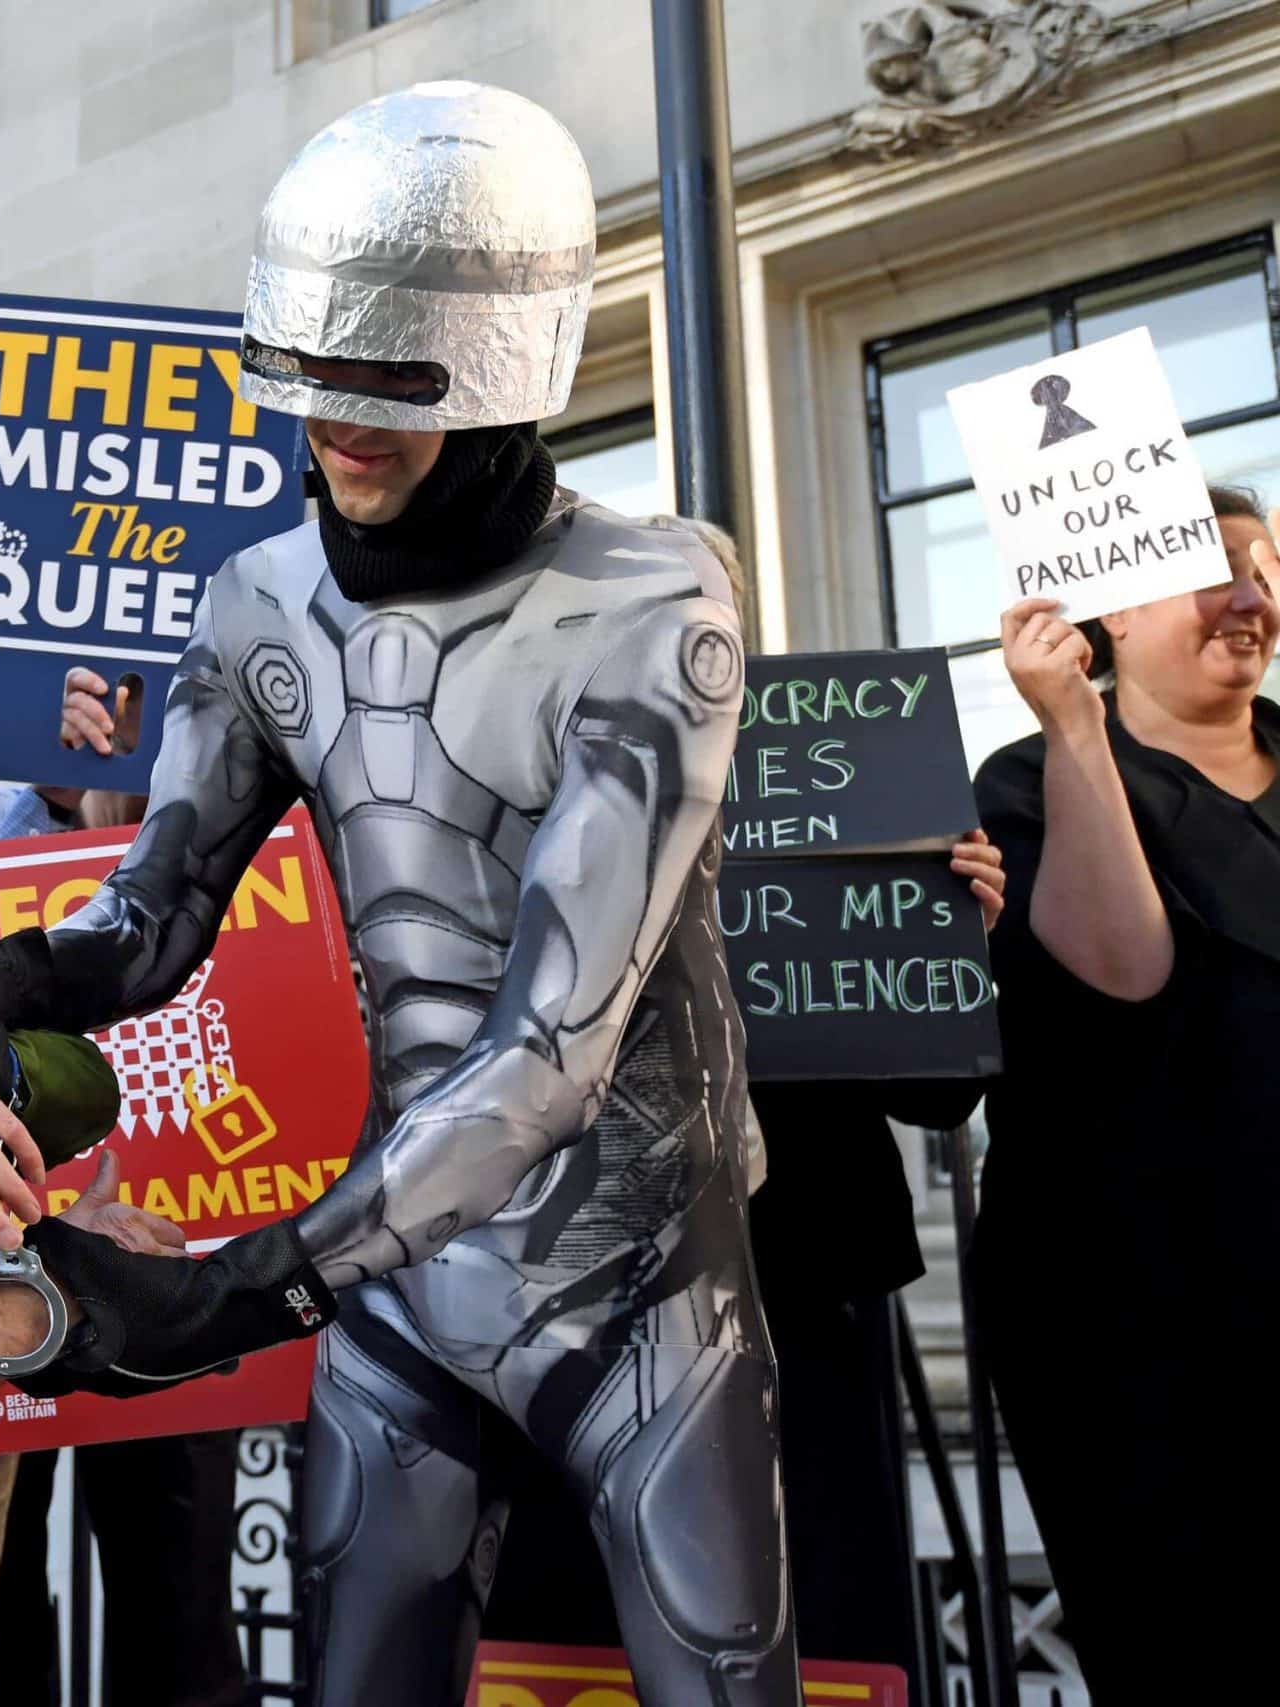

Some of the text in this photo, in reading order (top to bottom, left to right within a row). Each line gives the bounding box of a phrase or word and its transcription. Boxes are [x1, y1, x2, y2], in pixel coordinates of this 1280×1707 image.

[1001, 438, 1177, 517] UNLOCK
[67, 501, 187, 564] The
[1063, 494, 1141, 534] OUR
[1016, 516, 1217, 596] PARLIAMENT
[736, 673, 928, 730] CRACY
[725, 739, 856, 803] IES
[717, 878, 953, 937] UR MPs
[746, 957, 993, 1015] SILENCED
[7, 1403, 57, 1422] BRITAIN
